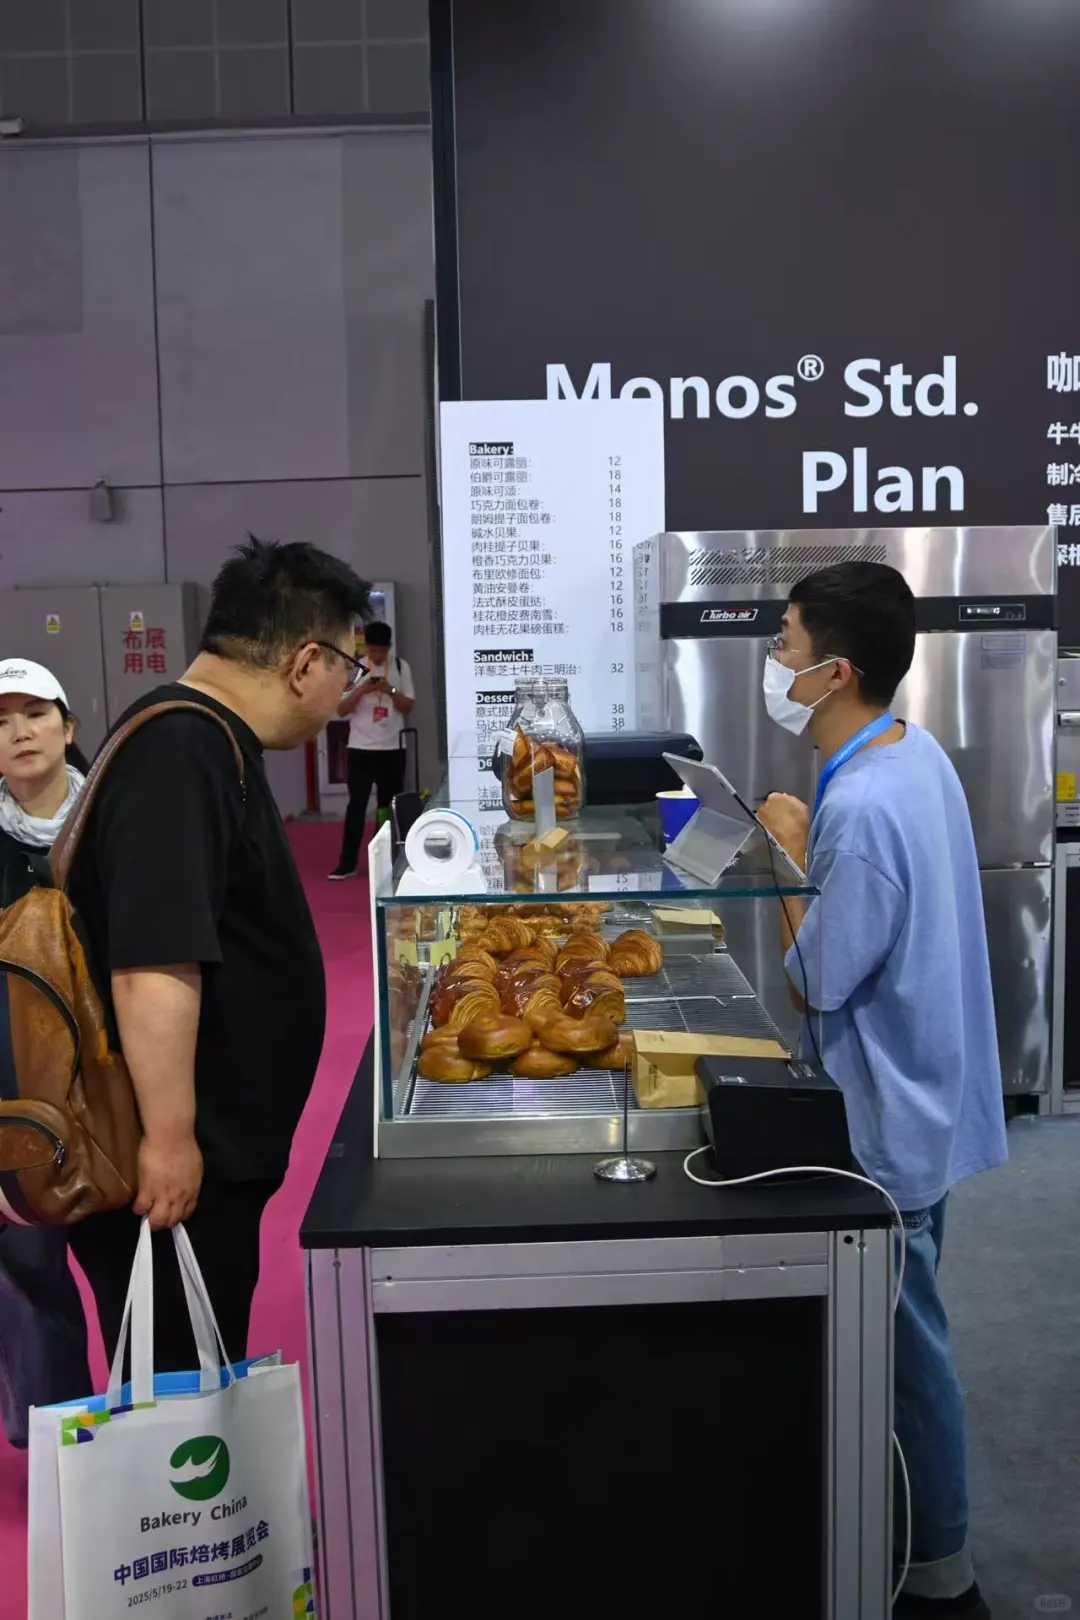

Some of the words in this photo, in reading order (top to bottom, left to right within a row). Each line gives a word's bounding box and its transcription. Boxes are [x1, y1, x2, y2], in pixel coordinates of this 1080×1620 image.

[844, 355, 979, 418] Std.
[469, 443, 514, 456] Bakery:
[608, 456, 621, 466] 12
[608, 470, 621, 480] 18
[802, 447, 965, 513] Plan
[609, 484, 621, 493] 14
[609, 498, 622, 507] 18
[609, 512, 622, 521] 18
[609, 526, 622, 535] 12
[609, 540, 622, 549] 16
[610, 553, 623, 563] 16
[610, 567, 623, 577] 12
[610, 581, 623, 590] 12
[610, 595, 623, 604] 16
[611, 609, 624, 618] 16
[710, 610, 737, 619] Turbo
[737, 610, 752, 619] air
[611, 622, 624, 632] 18
[122, 628, 167, 649] 布展
[474, 650, 534, 662] Sandwich:
[123, 652, 167, 674] 用电
[611, 662, 624, 673] 32
[476, 692, 516, 703] Desser
[612, 703, 625, 714] 38
[612, 717, 625, 728] 38
[140, 1511, 201, 1532] Bakery
[210, 1496, 248, 1520] China
[114, 1520, 269, 1586] 中国国际焙烤展览会
[127, 1579, 188, 1607] 2025/5/19-22
